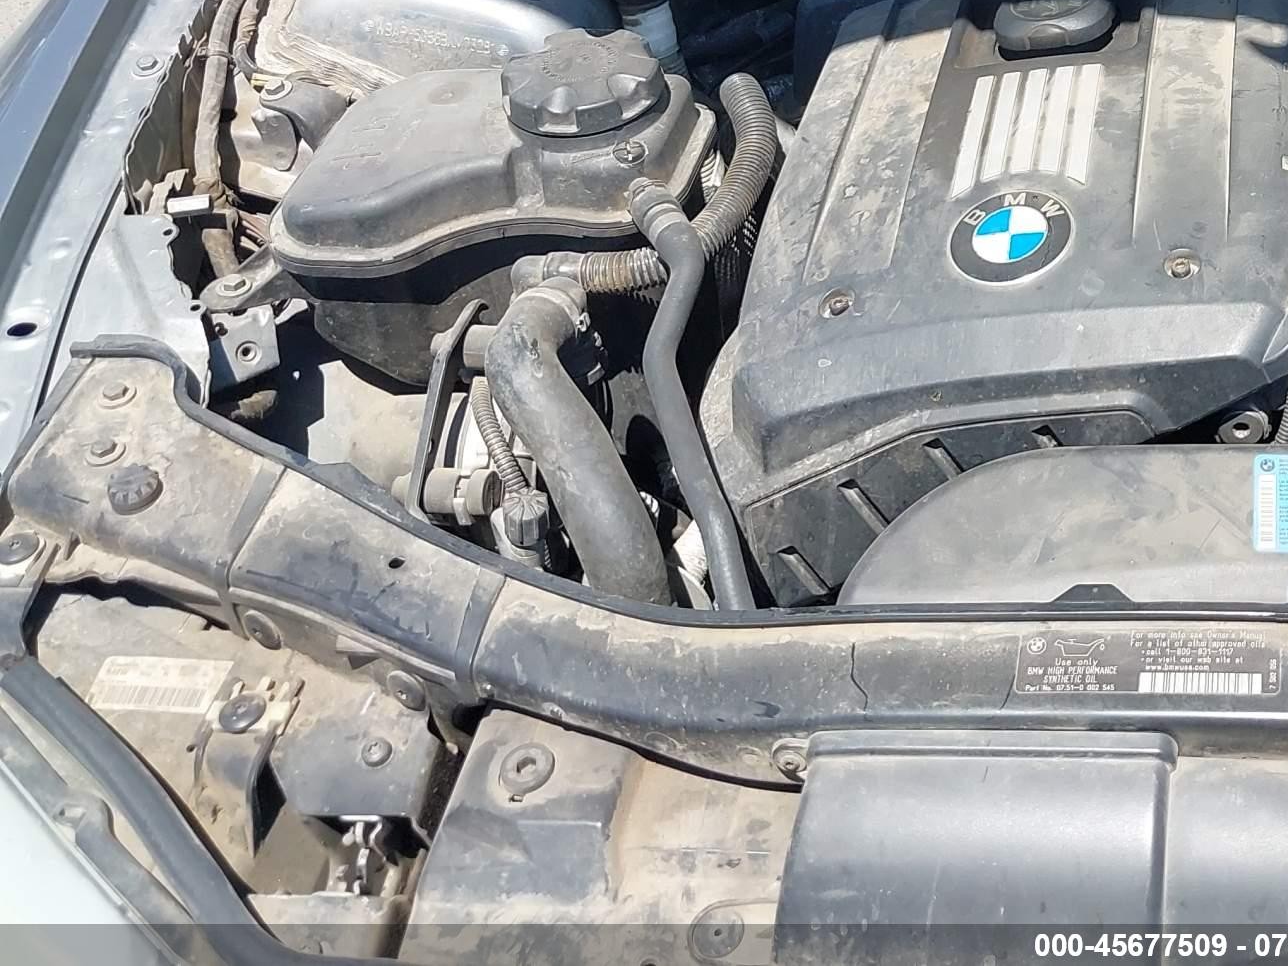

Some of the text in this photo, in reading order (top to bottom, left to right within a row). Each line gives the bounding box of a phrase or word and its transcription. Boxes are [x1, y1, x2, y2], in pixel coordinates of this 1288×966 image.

[963, 192, 1065, 226] BMW
[1130, 630, 1143, 639] For
[1170, 630, 1186, 639] info
[1207, 631, 1235, 639] Owner's
[1130, 638, 1143, 647] For
[1156, 639, 1170, 647] list
[1174, 639, 1184, 647] of
[1212, 639, 1246, 649] approved
[1146, 648, 1161, 656] call
[1055, 658, 1098, 667] Use only
[1216, 656, 1231, 664] site
[1027, 666, 1118, 675] BMW HIGH PERFORMANCE
[1043, 675, 1097, 684] SYNTHETIC OIL
[1025, 684, 1039, 692] Part
